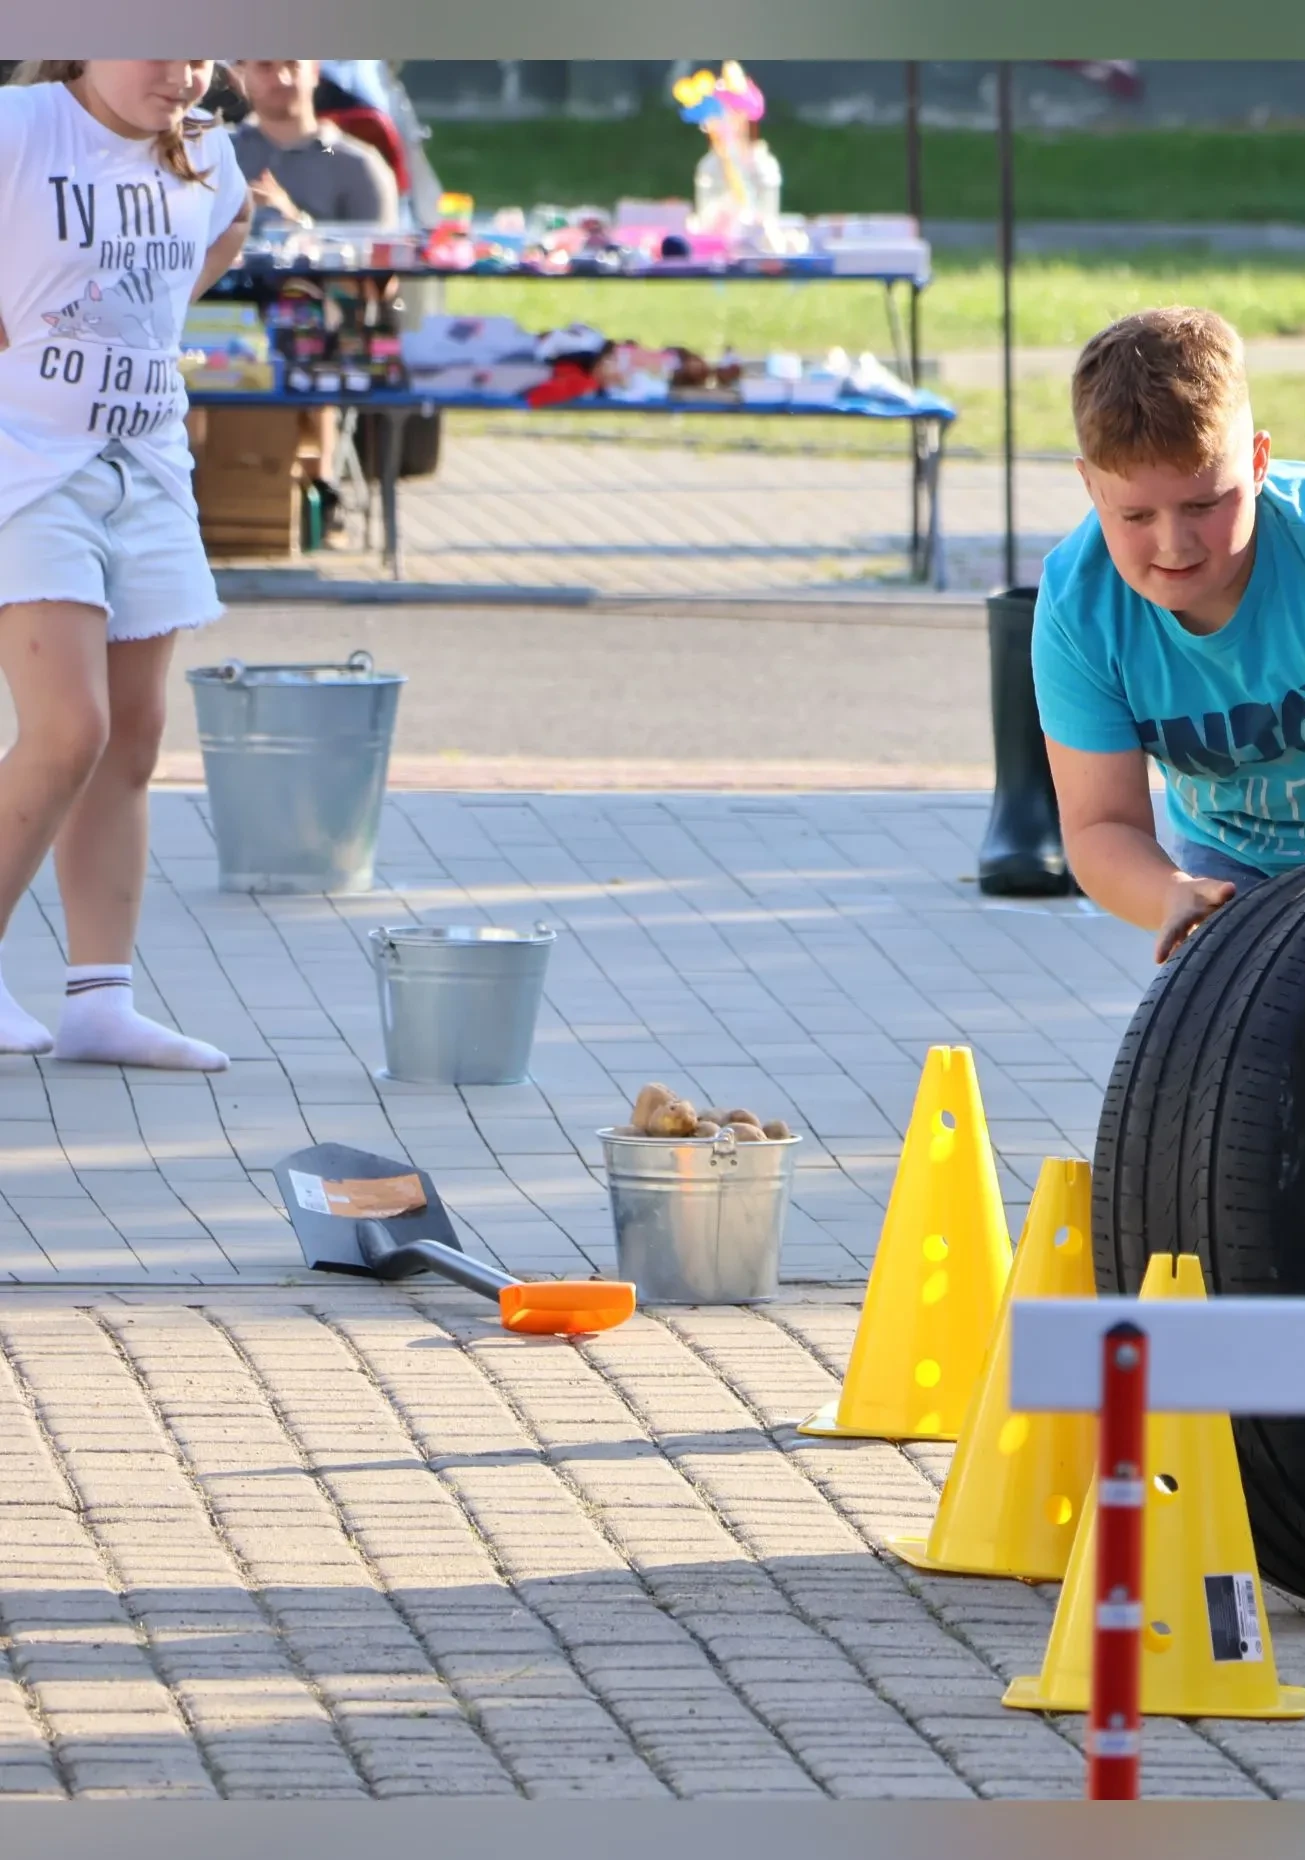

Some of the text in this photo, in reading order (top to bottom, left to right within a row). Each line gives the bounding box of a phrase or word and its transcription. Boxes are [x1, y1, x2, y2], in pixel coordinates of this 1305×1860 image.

[48, 168, 172, 249] Ty mi
[99, 234, 196, 271] nie mów
[39, 346, 179, 395] co ja ma
